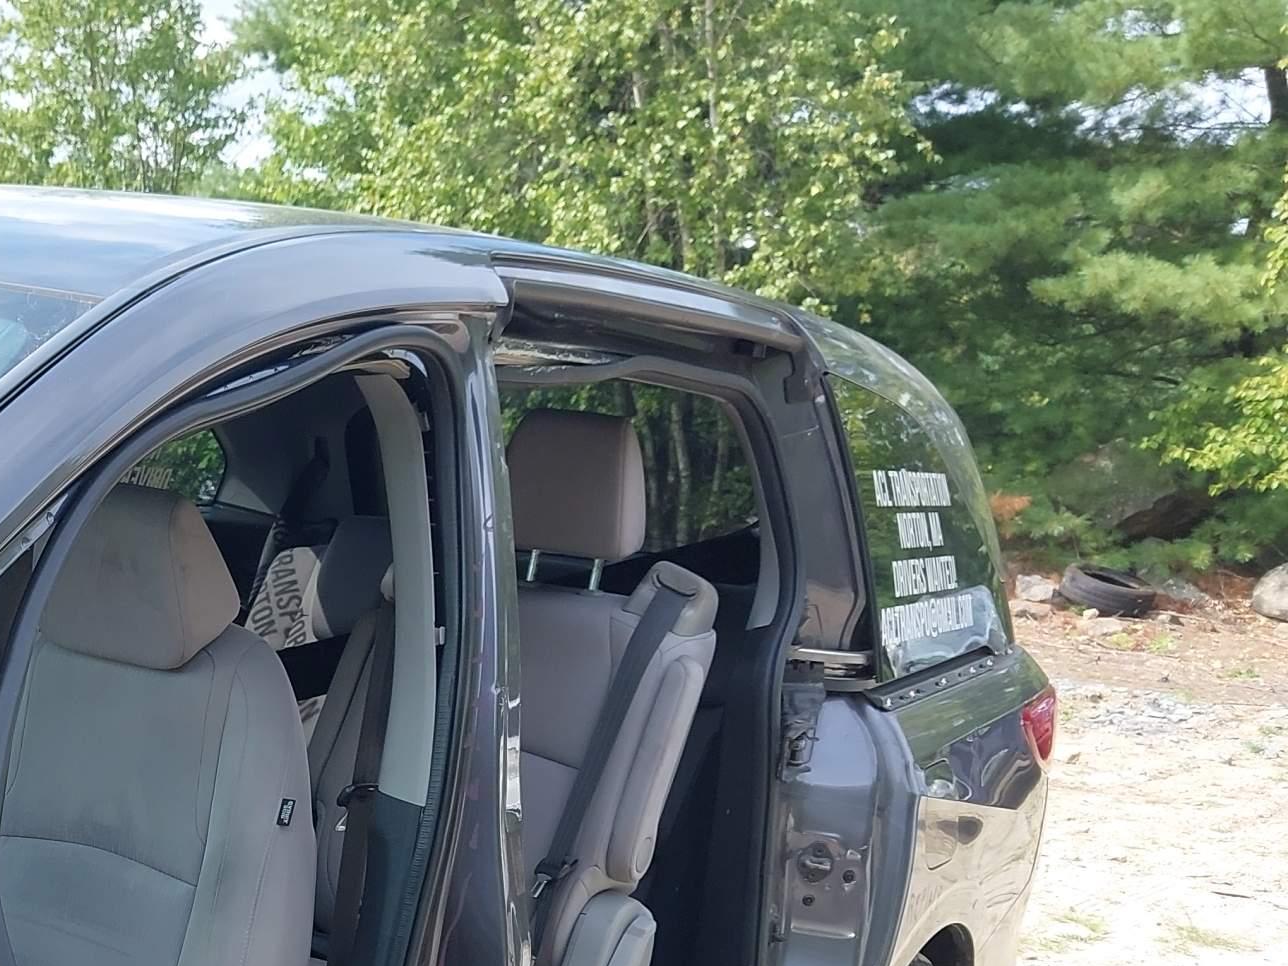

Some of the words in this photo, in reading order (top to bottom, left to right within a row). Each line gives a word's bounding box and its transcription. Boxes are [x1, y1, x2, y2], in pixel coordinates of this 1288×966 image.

[887, 469, 952, 507] TRANSPORTATION
[892, 558, 927, 598] DRIVERS
[269, 551, 308, 647] RANSPOR
